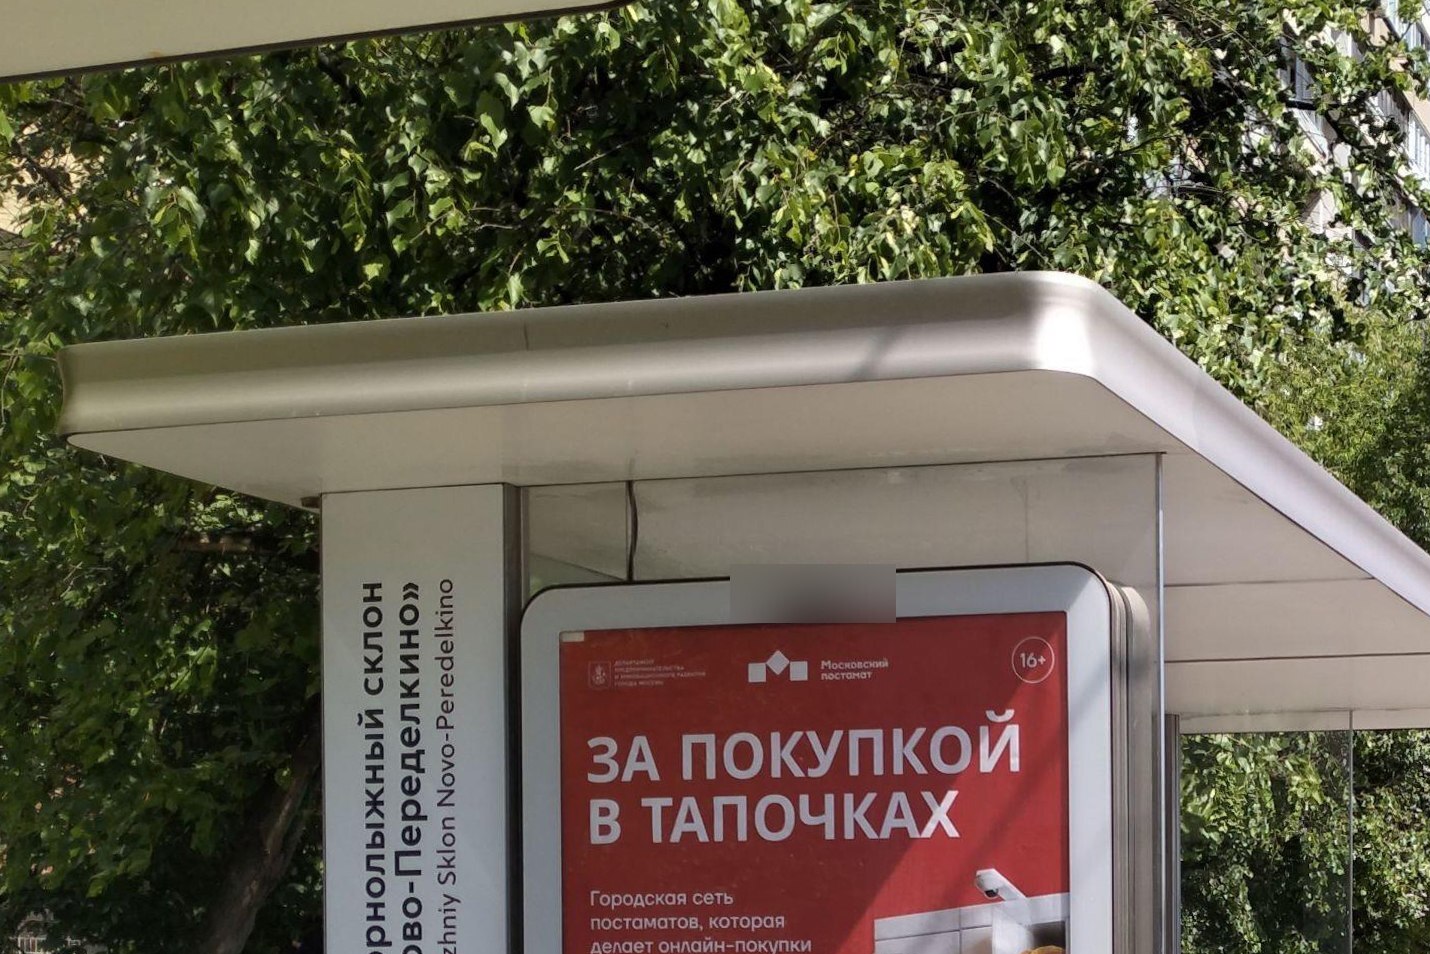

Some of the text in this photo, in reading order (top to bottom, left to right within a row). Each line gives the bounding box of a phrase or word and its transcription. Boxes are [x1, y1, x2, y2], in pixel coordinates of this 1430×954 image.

[363, 583, 383, 695] склон
[820, 658, 889, 669] Московский
[1020, 652, 1046, 668] 16+
[820, 672, 872, 681] постамат
[434, 579, 455, 806] Novo-Peredelkino
[588, 709, 1019, 783] ЗА ПОКУПКОЙ
[590, 790, 960, 844] В ТАПОЧКАХ
[436, 817, 456, 885] Sklon
[591, 890, 733, 910] Городская сеть
[591, 916, 784, 931] постаматов, которая
[590, 938, 653, 954] делает
